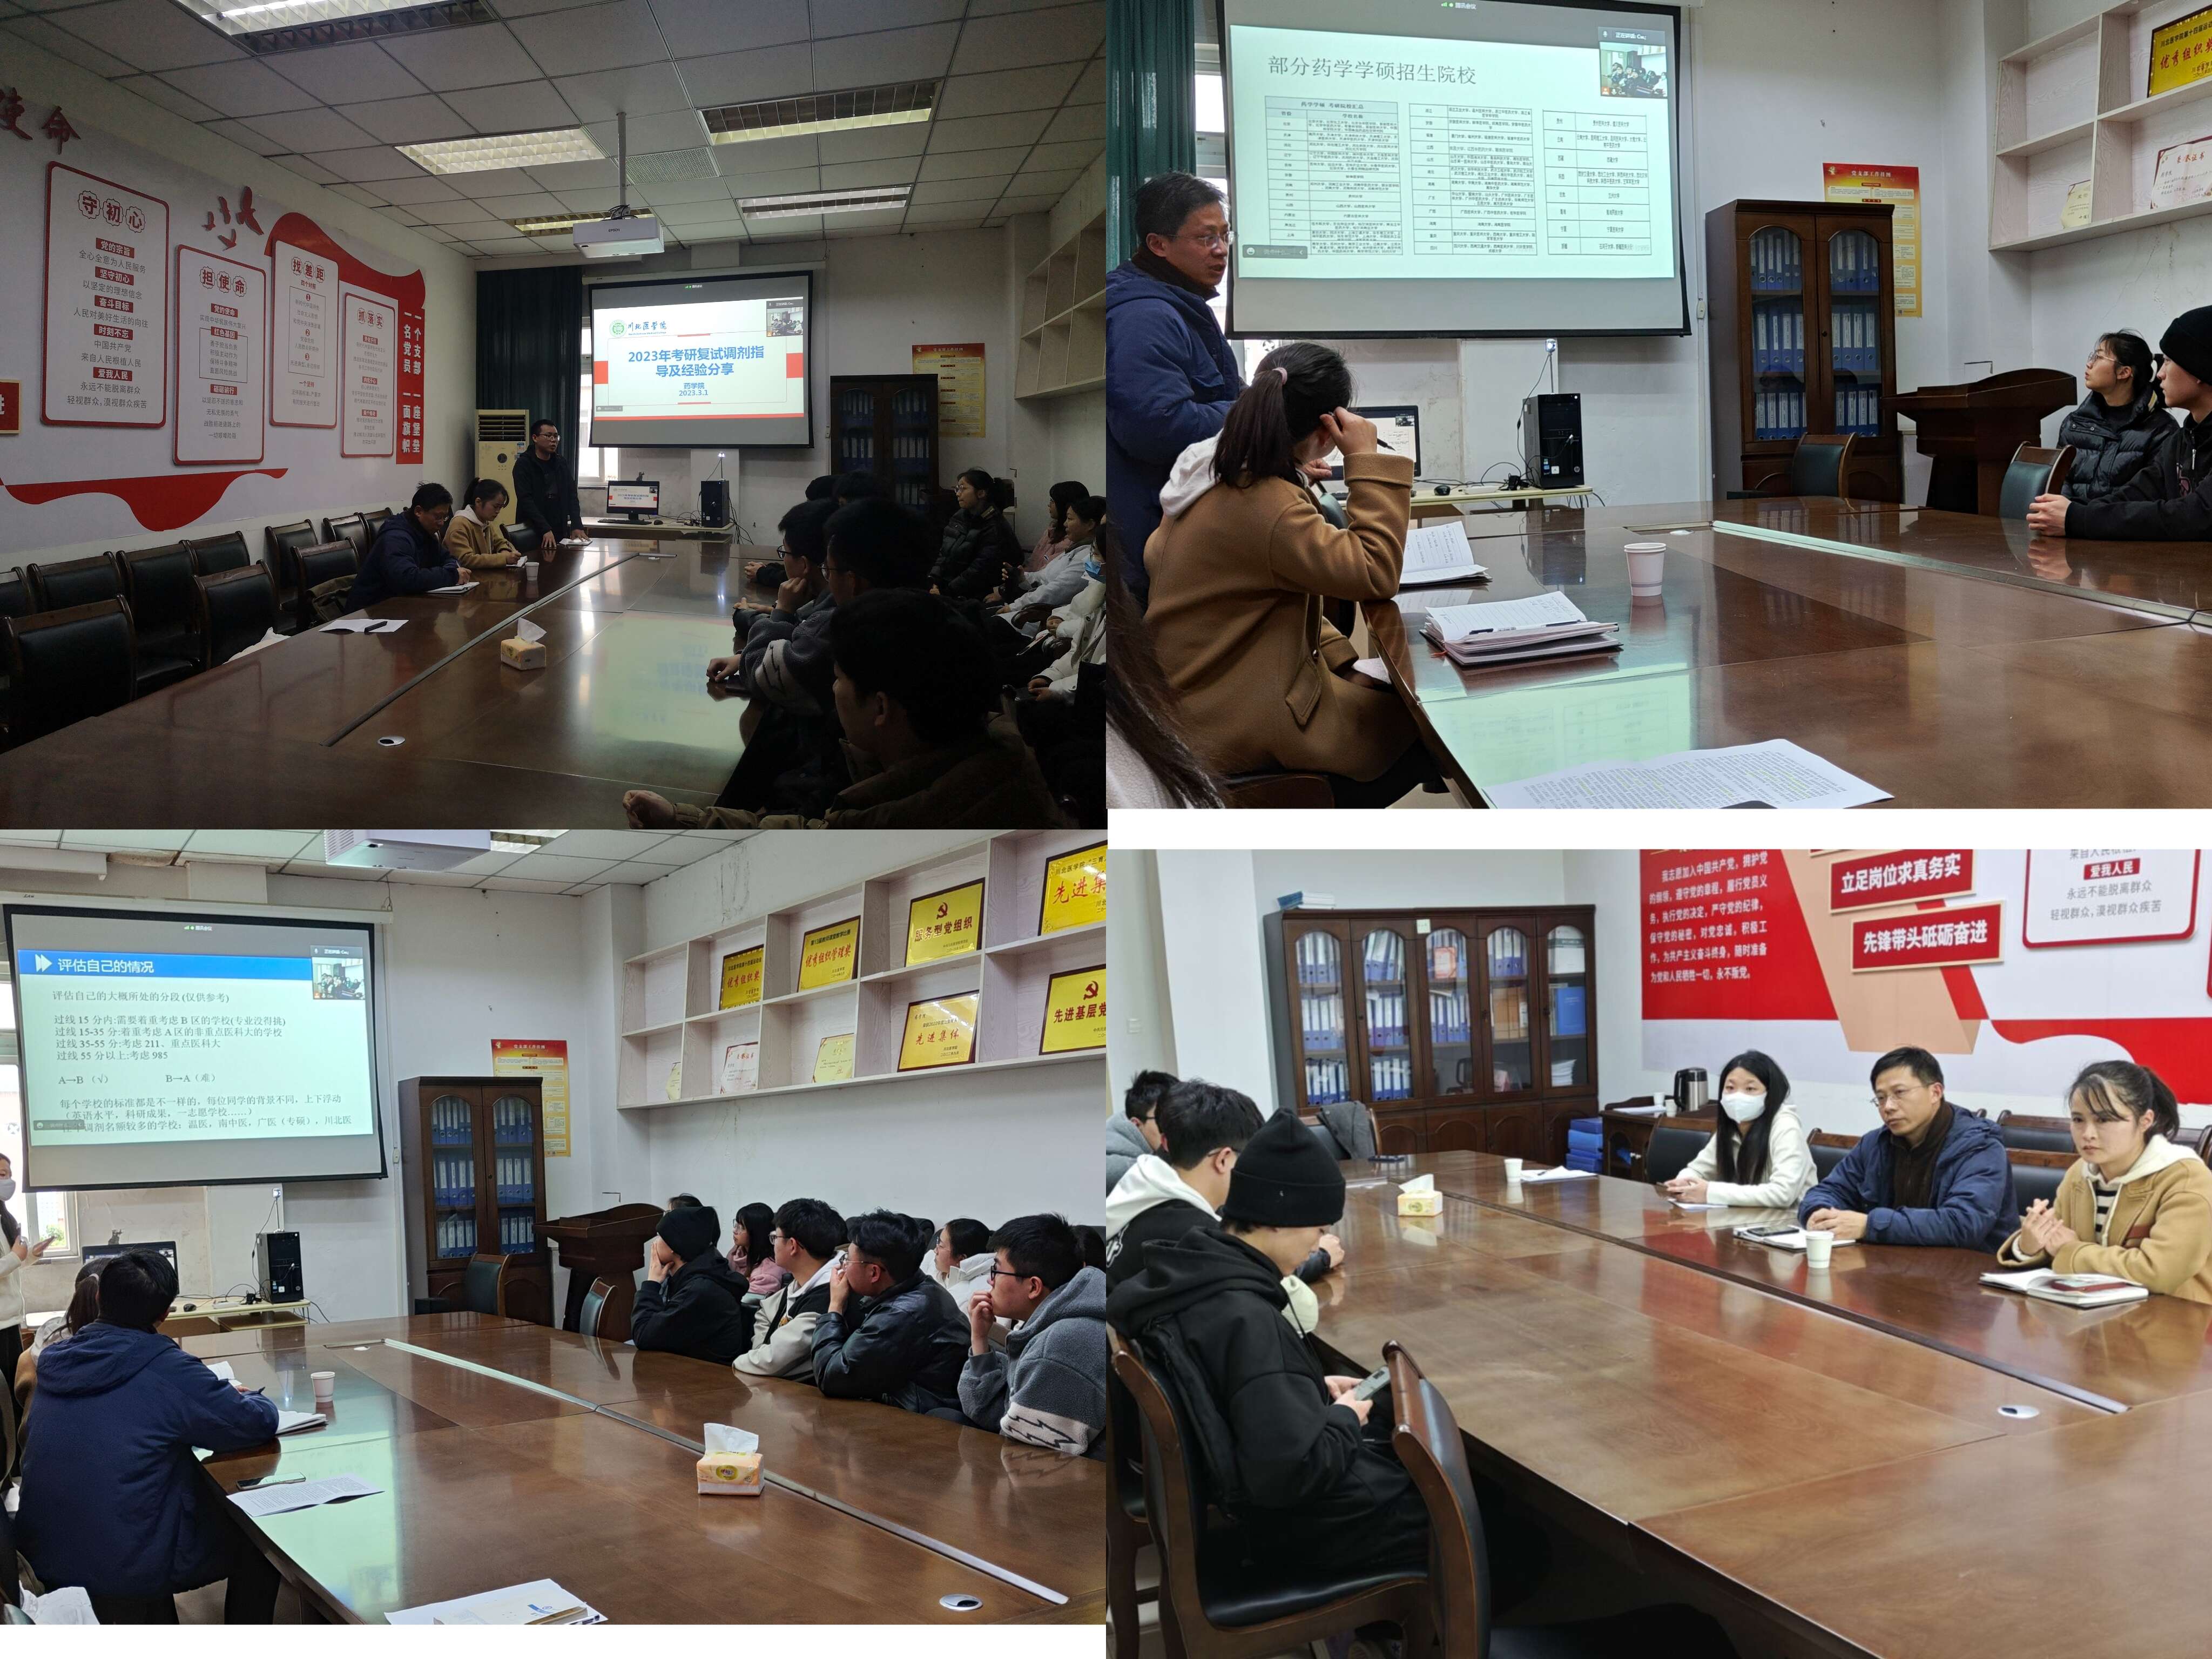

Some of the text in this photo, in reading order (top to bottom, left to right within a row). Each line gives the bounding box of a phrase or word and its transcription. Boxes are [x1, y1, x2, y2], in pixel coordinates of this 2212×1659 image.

[2160, 37, 2212, 70] 优秀组织奖
[1268, 56, 1476, 84] 部分药学学硕招生院校
[82, 195, 143, 230] 守初心
[101, 240, 130, 257] 党的宗旨
[79, 249, 146, 274] 全心全意为人民服务
[293, 259, 325, 281] 找差距
[100, 269, 130, 284] 坚守初心
[202, 269, 245, 294] 担使命
[83, 280, 143, 300] 以坚定的理想信念
[99, 298, 130, 311] 奋斗目标
[214, 305, 235, 316] 党的使命
[73, 307, 149, 328] 人民对美好生活的向往
[359, 311, 383, 327] 抓落实
[628, 321, 667, 332] 川北医学院
[99, 326, 129, 339] 时刻不忘
[214, 328, 235, 339] 红色基因
[95, 340, 132, 353] 中国共产党
[628, 346, 764, 362] 2023年考研复试调剂指
[82, 353, 141, 368] 来自人民根植人民
[656, 362, 734, 377] 导及经验分享
[98, 369, 129, 380] 爱我人民
[402, 312, 412, 453] 一名党员 一面旗帜
[80, 382, 141, 395] 永远不能脱离群众
[412, 315, 422, 453] 一个支部 一座堡垒
[1662, 851, 1768, 882] 我志愿加入中国共产党，拥护党
[1841, 853, 1961, 894] 立足岗位求真务实
[2090, 860, 2134, 878] 爱我人民
[1649, 874, 1768, 905] 的纲领，遵守党的章程，履行党员义
[2067, 880, 2152, 900] 永远不能脱离群众
[1650, 898, 1764, 925] 务，执行党的决定，严守党的纪律，
[915, 916, 973, 942] 服务型党组织
[1650, 921, 1768, 944] 保守党的秘密，对党忠诚，积极工
[1864, 919, 1987, 954] 先锋带头砥砺奋进
[805, 943, 851, 968] 优秀组织管理奖
[1650, 942, 1767, 963] 作，为共产主义奋斗终身，随时准备
[57, 958, 154, 974] 评估自己的情况
[1651, 966, 1751, 983] 为党和人民牺牲一切，永不叛党。
[727, 969, 760, 988] 优秀组织奖
[53, 990, 180, 1002] 评估自己的大概所处的分段
[54, 1015, 76, 1024] 过线
[79, 1016, 89, 1024] 15
[1053, 1001, 1106, 1023] 先进基层党
[55, 1027, 76, 1037] 过线
[79, 1028, 104, 1036] 15-35
[915, 1028, 959, 1045] 先进集体
[56, 1039, 77, 1048] 过线
[80, 1040, 105, 1048] 35-55
[57, 1051, 78, 1061] 过线
[81, 1052, 91, 1060] 55
